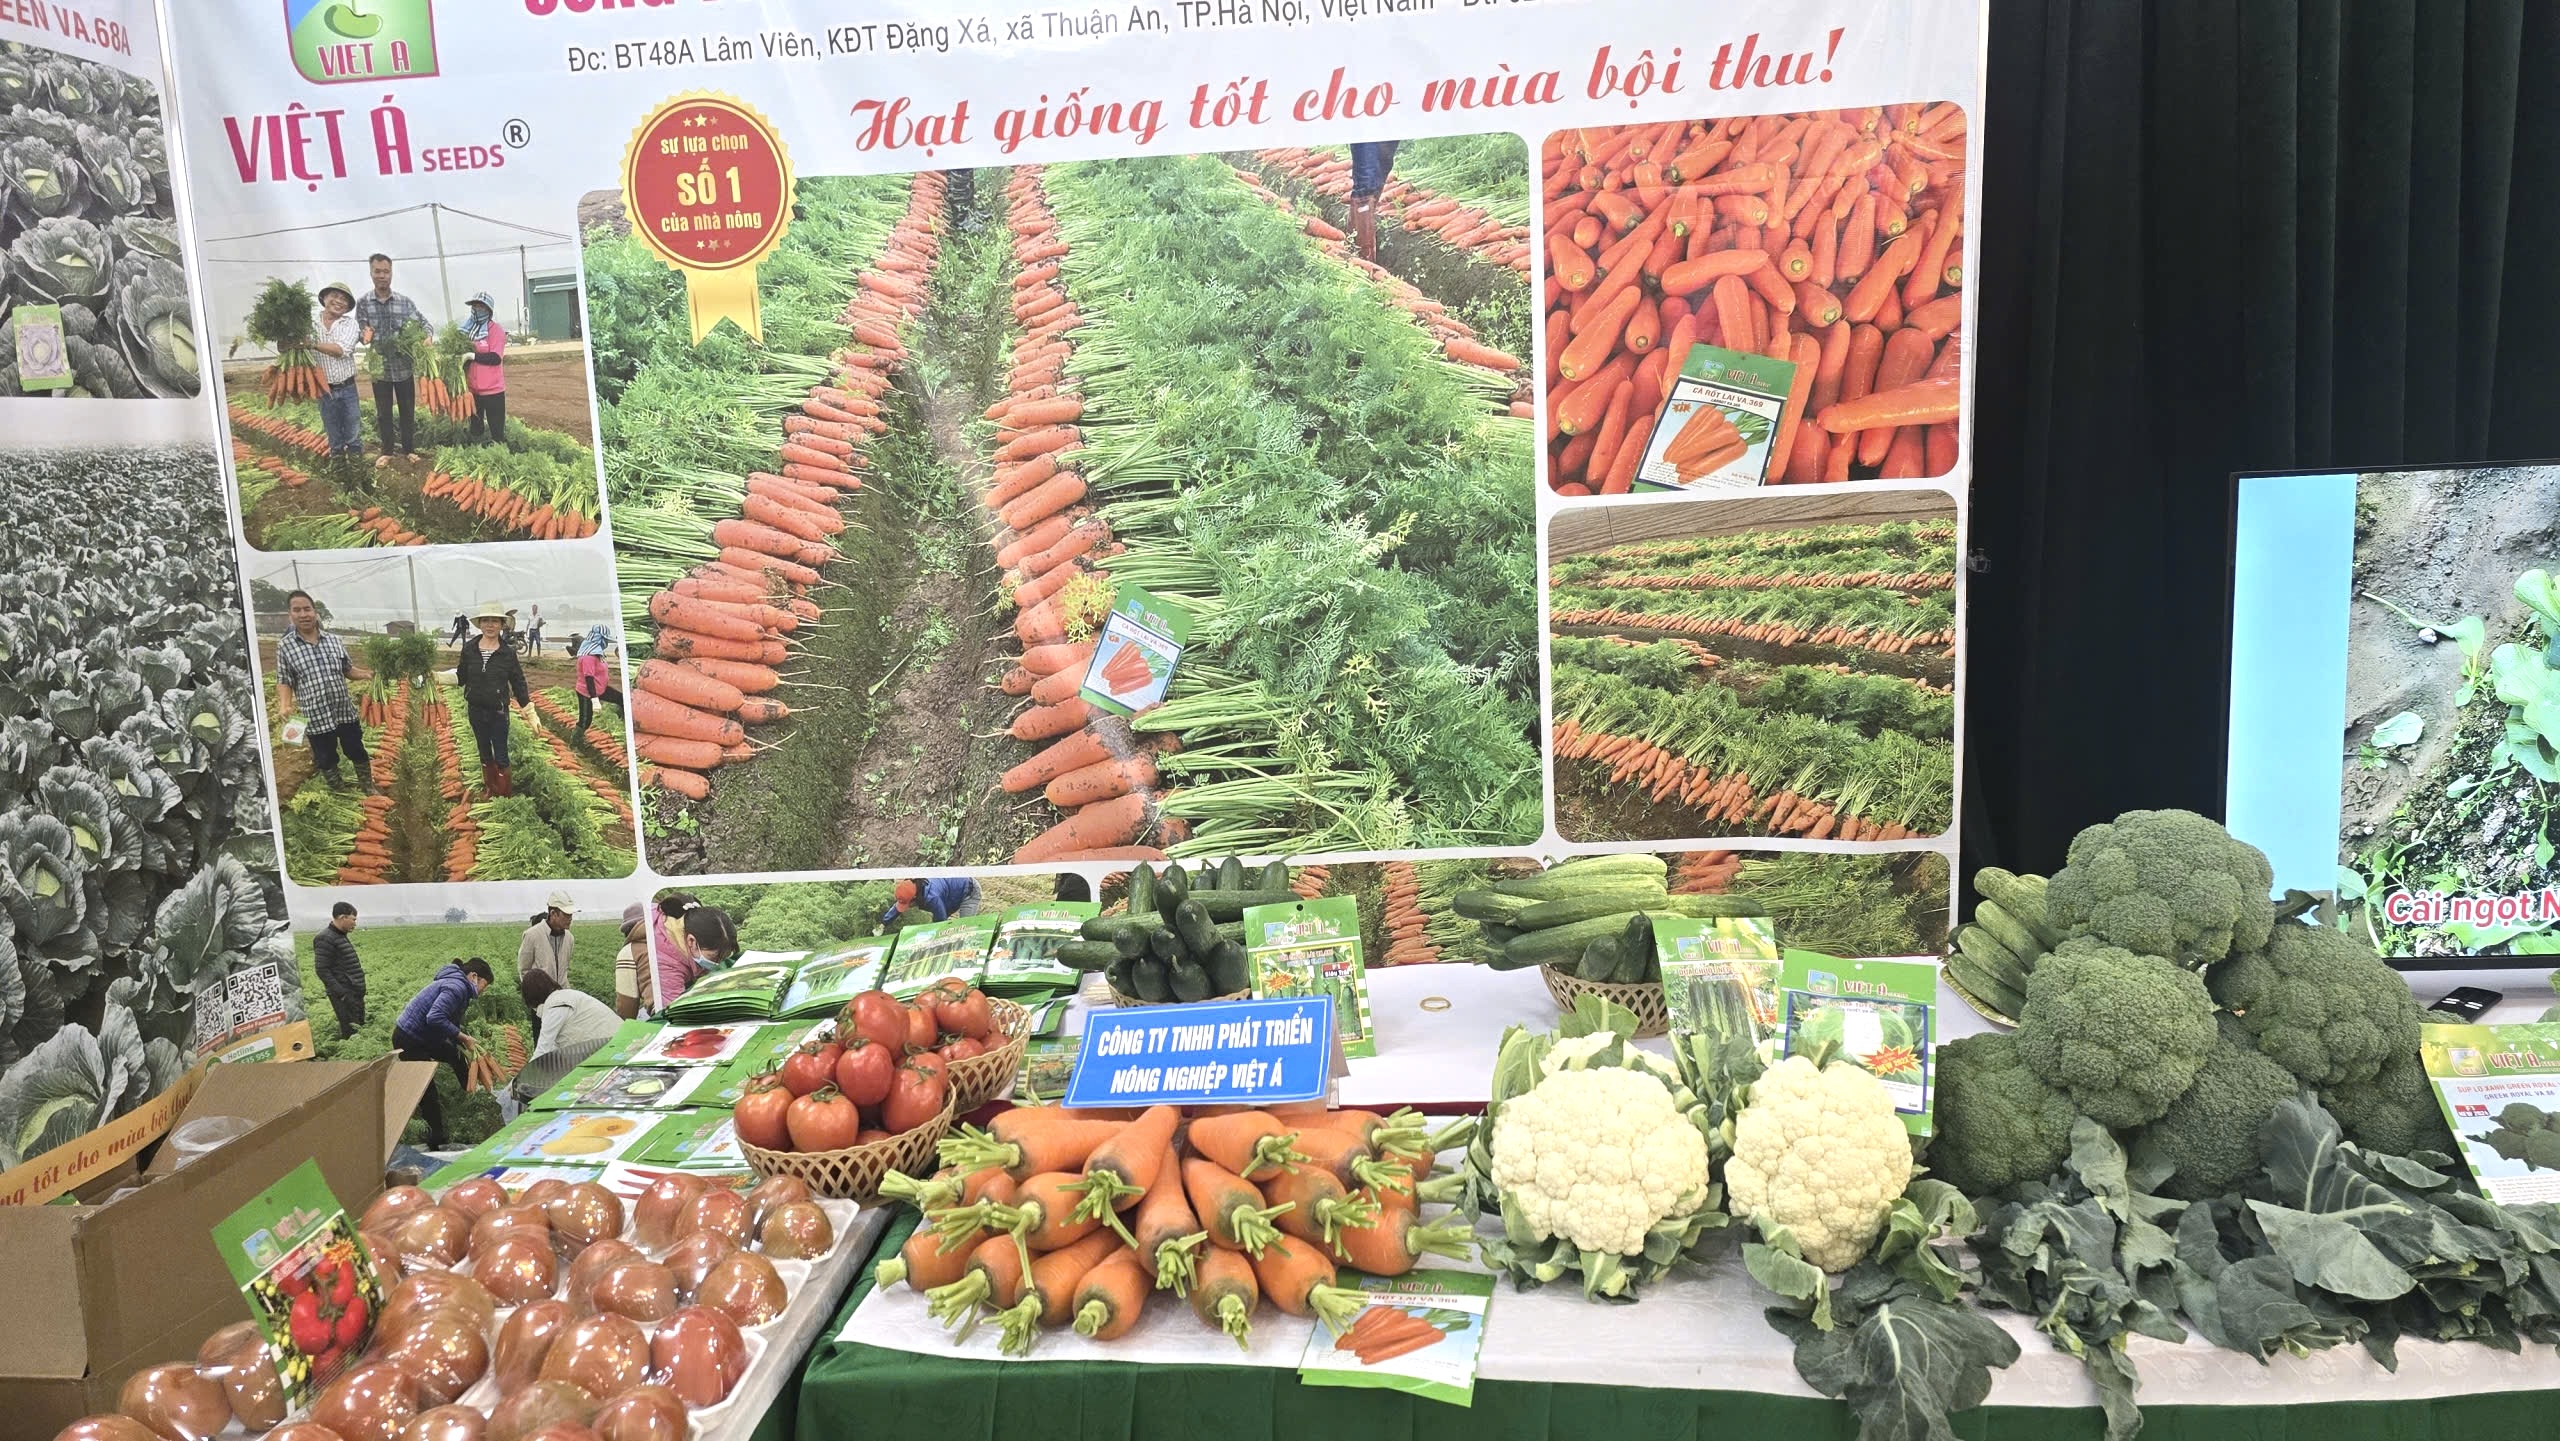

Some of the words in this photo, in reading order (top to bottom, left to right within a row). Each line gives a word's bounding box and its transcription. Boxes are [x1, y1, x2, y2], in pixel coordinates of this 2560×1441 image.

[52, 4, 131, 56] VA.68A
[568, 47, 607, 72] Đc:
[616, 40, 694, 68] BT48A
[703, 36, 753, 62] Lâm
[761, 31, 821, 60] Viên,
[828, 25, 877, 54] KĐT
[887, 22, 949, 52] Đặng
[958, 16, 997, 47] Xá,
[1006, 17, 1034, 41] xã
[1042, 9, 1118, 40] Thuận
[1127, 6, 1169, 34] An,
[850, 97, 973, 157] Hạt
[994, 86, 1168, 156] giống
[1189, 75, 1272, 129] tốt
[1292, 66, 1401, 122] cho
[1421, 63, 1566, 113] mùa
[1587, 45, 1686, 108] bội
[1709, 27, 1846, 91] thu!
[223, 102, 347, 192] VIỆT
[370, 95, 413, 175] Á
[423, 144, 505, 172] SEEDS
[661, 136, 679, 157] sự
[684, 135, 707, 157] lựa
[712, 133, 749, 154] chọn
[676, 157, 717, 206] SỐ
[726, 166, 741, 203] 1
[661, 212, 689, 233] của
[693, 212, 721, 231] nhà
[726, 210, 762, 229] nông
[2388, 892, 2442, 922] Cải
[2453, 894, 2531, 927] ngọt
[227, 1045, 255, 1060] Hotline
[1097, 1024, 1144, 1056] CÔNG
[1148, 1026, 1170, 1054] TY
[1171, 1024, 1215, 1052] TNHH
[1217, 1016, 1261, 1049] PHÁT
[1265, 1006, 1313, 1047] TRIỂN
[1110, 1065, 1162, 1093] NÔNG
[1163, 1060, 1227, 1095] NGHIỆP
[1232, 1062, 1269, 1093] VIỆT
[1270, 1057, 1283, 1087] Á
[2488, 1051, 2523, 1069] VIỆT
[2484, 1092, 2509, 1100] GREEN
[33, 1164, 60, 1194] tốt
[67, 1149, 100, 1176] cho
[108, 1126, 147, 1157] mùa
[150, 1105, 168, 1131] bội
